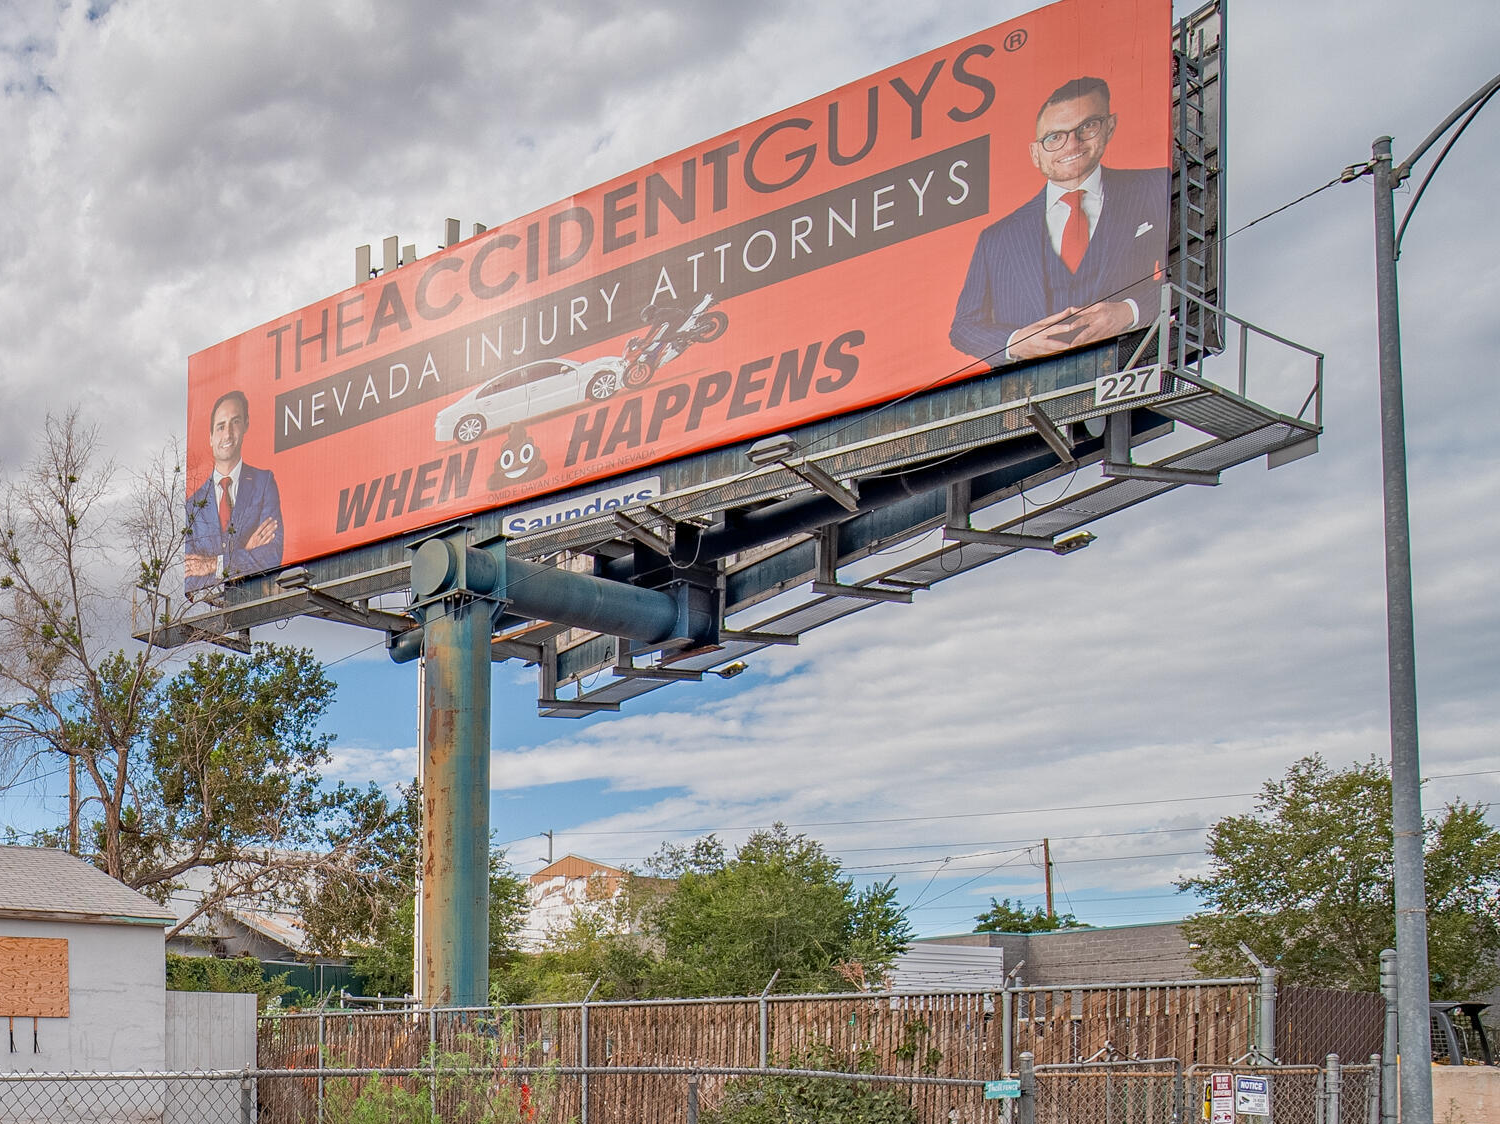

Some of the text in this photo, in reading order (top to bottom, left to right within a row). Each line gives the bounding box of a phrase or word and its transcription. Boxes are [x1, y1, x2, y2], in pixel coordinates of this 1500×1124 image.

[284, 160, 970, 437] NEVADA INJURY ATTORNEYS
[1100, 368, 1155, 402] 227
[336, 329, 867, 534] WHEN HAPPENS
[562, 464, 604, 481] LICENSED
[618, 448, 655, 465] NEVADA
[1240, 1081, 1263, 1091] NOTICE
